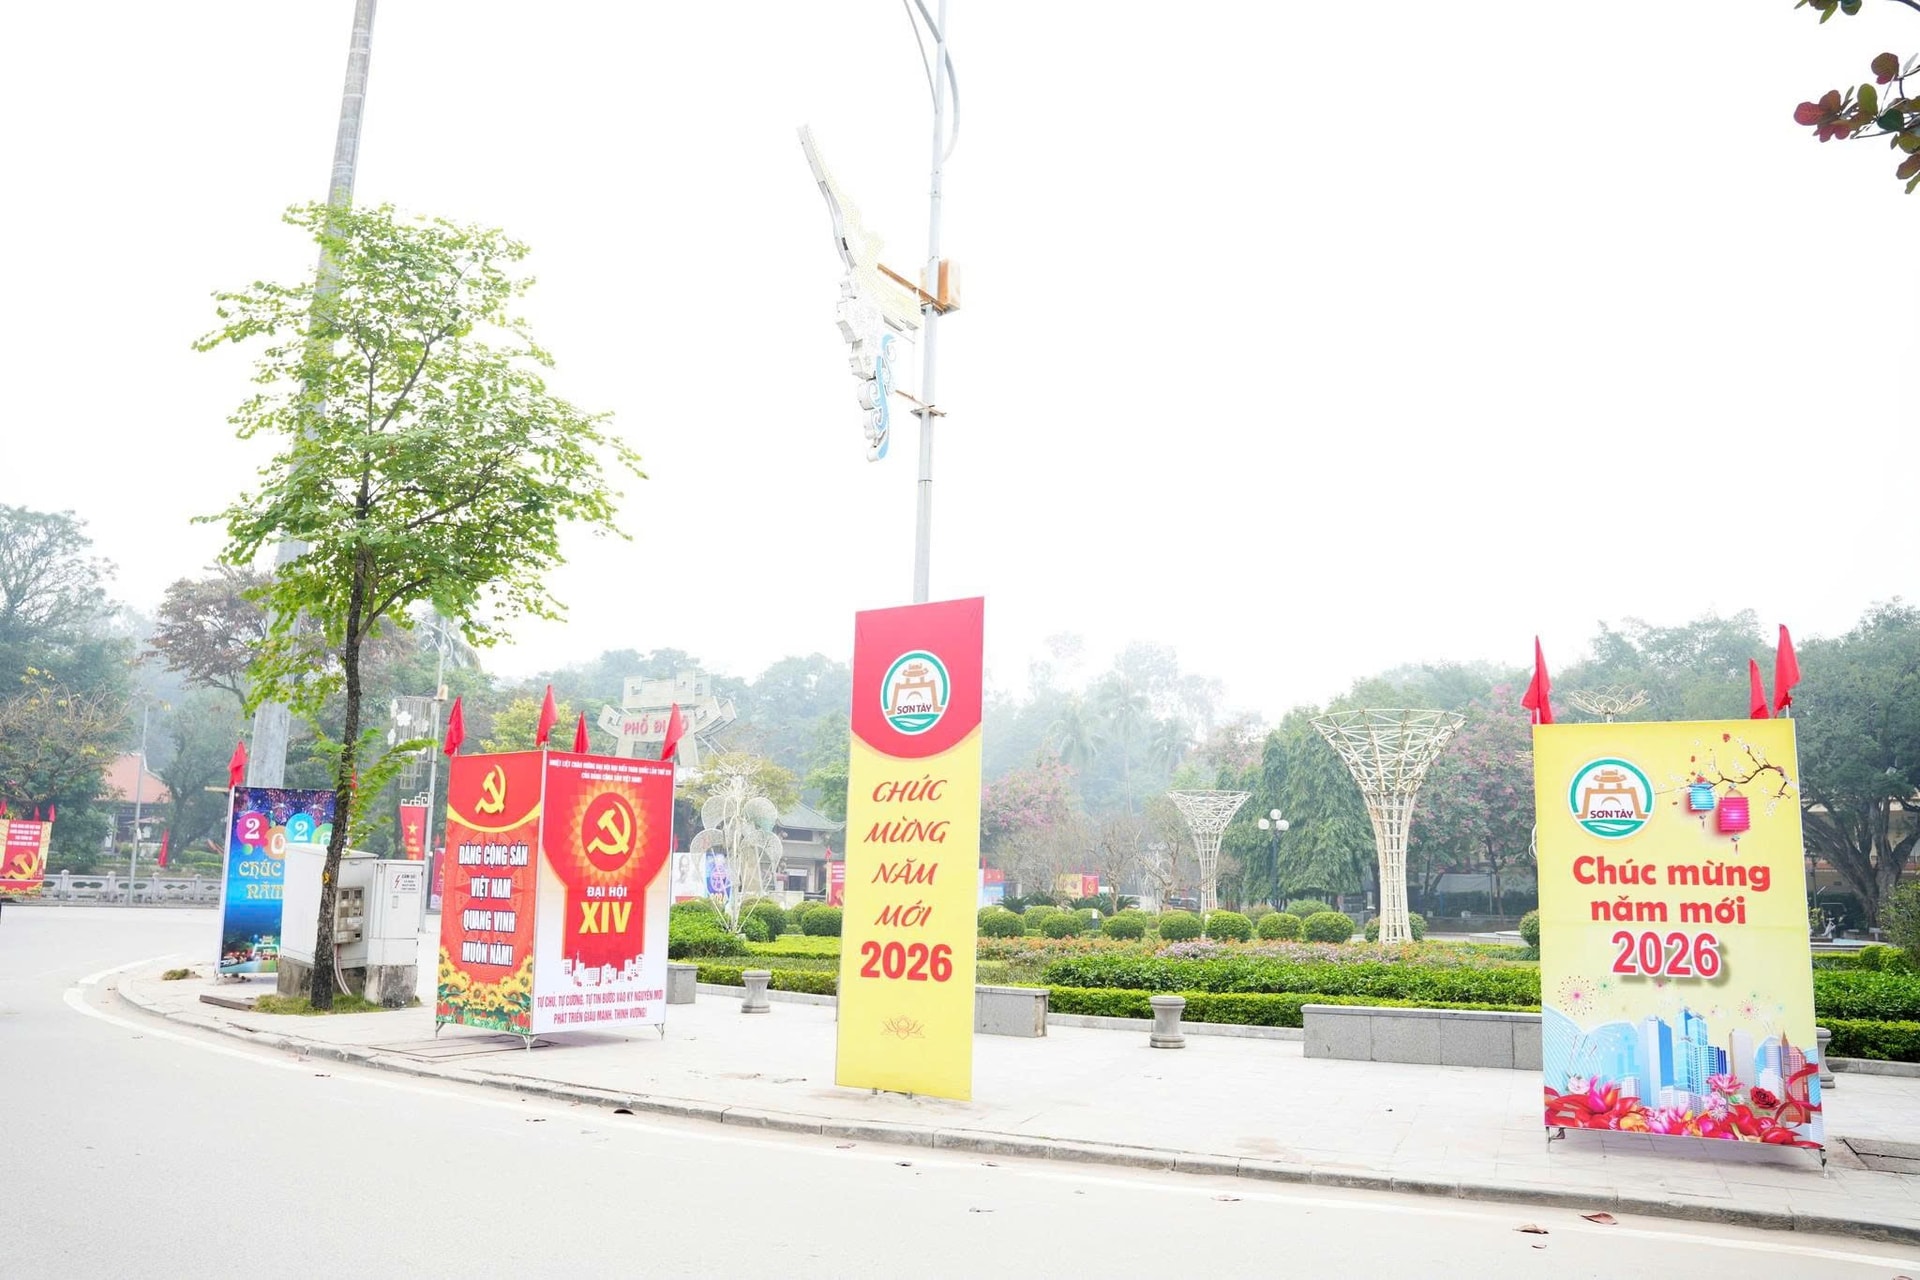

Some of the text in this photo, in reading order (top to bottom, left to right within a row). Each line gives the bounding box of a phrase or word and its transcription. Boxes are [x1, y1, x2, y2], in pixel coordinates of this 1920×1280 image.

[916, 702, 932, 713] TÂY
[624, 713, 649, 735] PHỐ
[872, 774, 948, 803] CHÚC
[1589, 808, 1634, 819] SƠN TÂY
[863, 815, 951, 844] MỪNG
[483, 842, 508, 869] CỘNG
[509, 840, 529, 867] SẢN
[871, 858, 938, 885] NĂM
[1572, 855, 1771, 892] Chúc mừng
[470, 874, 512, 902] VIỆT NAM
[586, 884, 628, 900] ĐẠI HỘI
[463, 909, 516, 933] QUANG VINH
[578, 901, 633, 934] XIV
[874, 899, 932, 927] MỚI
[1590, 895, 1746, 925] năm mới
[461, 940, 513, 967] MUÔN NĂM!
[860, 940, 953, 982] 2026
[1611, 930, 1720, 977] 2026
